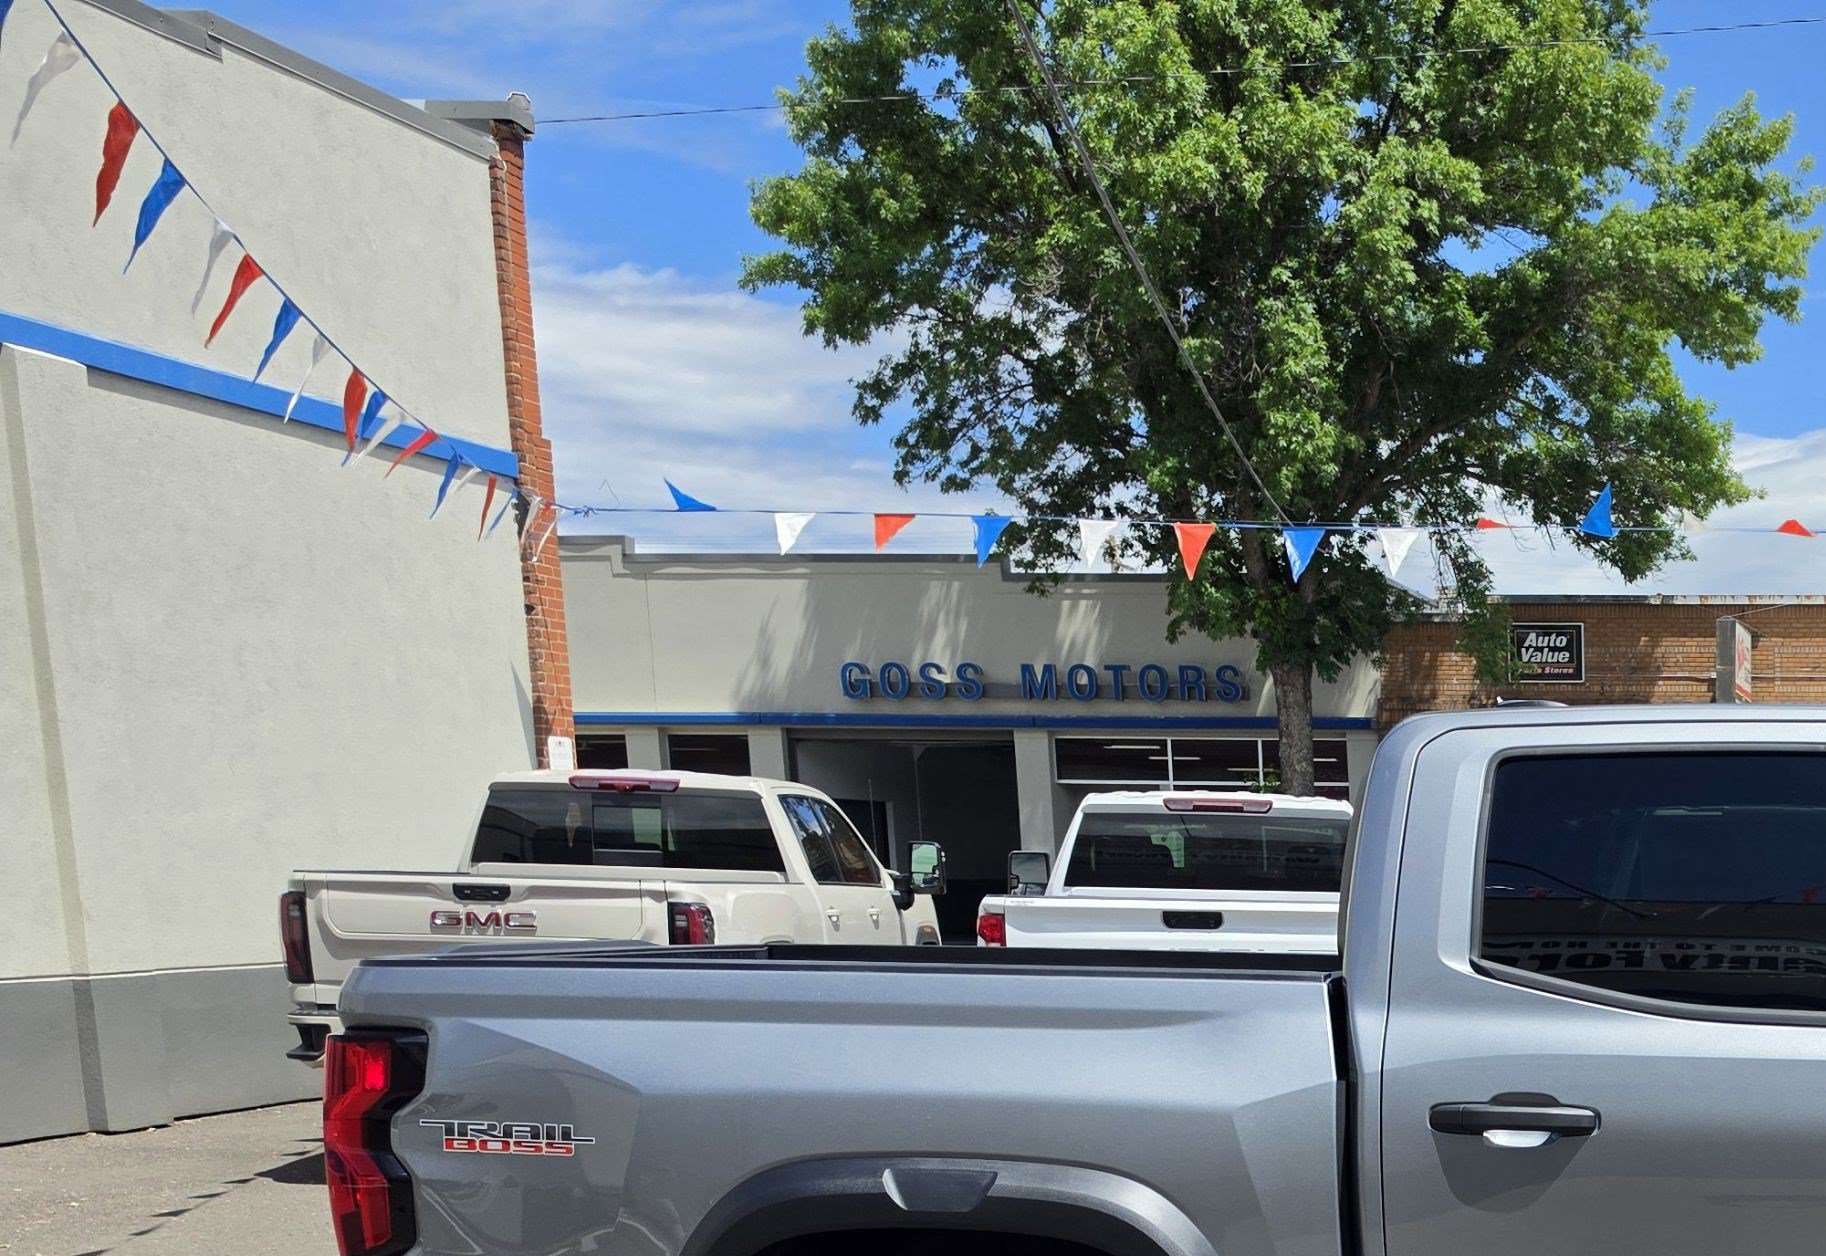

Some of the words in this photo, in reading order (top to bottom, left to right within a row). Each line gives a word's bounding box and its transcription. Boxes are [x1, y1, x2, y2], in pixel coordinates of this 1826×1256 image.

[1523, 632, 1569, 647] Auto
[1521, 647, 1570, 662] Value
[840, 662, 987, 701] GOSS
[1020, 663, 1245, 703] MOTORS
[430, 909, 537, 931] GMC
[420, 1119, 595, 1144] TRAIL
[443, 1137, 575, 1157] BOSS
